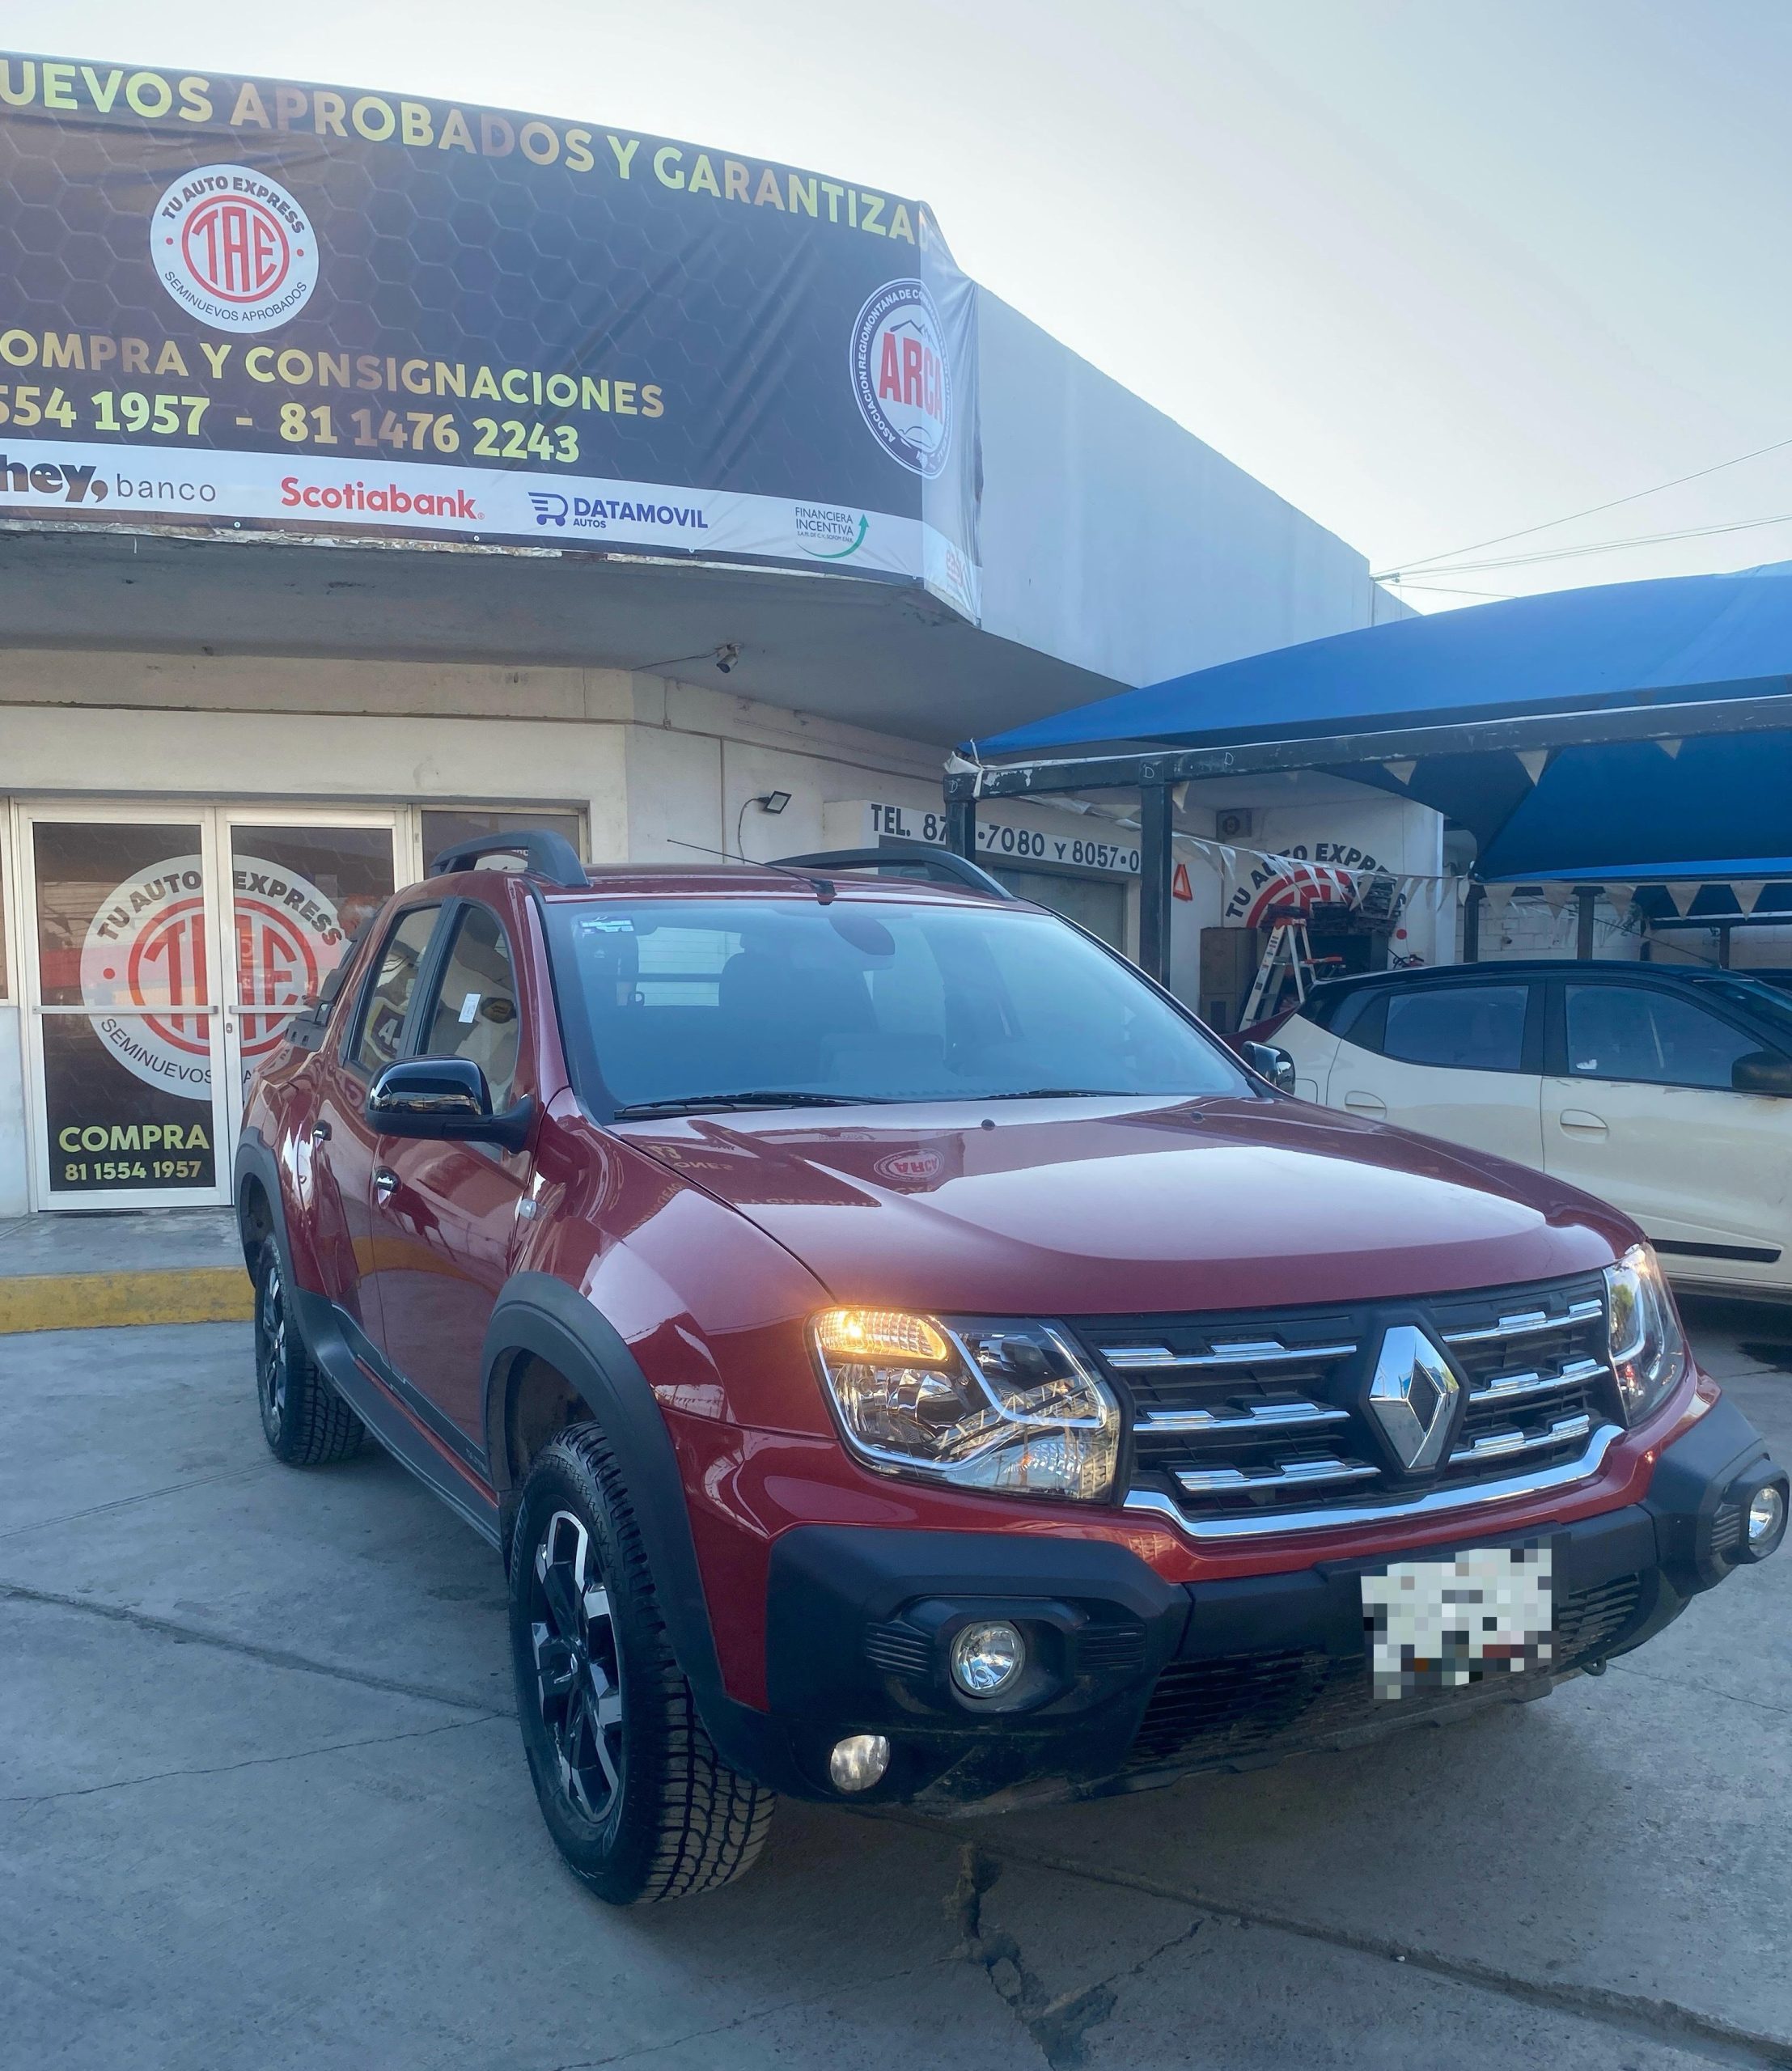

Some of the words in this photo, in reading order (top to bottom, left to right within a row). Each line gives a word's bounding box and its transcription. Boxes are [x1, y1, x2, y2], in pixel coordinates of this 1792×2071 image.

[0, 59, 213, 123] UEVOS
[230, 82, 595, 172] APROBADOS
[606, 135, 640, 180] Y
[162, 197, 184, 219] TU
[182, 176, 228, 202] AUTO
[233, 176, 305, 234] EXPRESS
[192, 206, 277, 292] TAE
[164, 271, 239, 321] SEMINUEVOS
[242, 282, 307, 322] APROBADOS
[899, 288, 912, 302] DE
[858, 290, 900, 370] REGIOMONTANA
[0, 329, 189, 378] OMPRA
[200, 342, 232, 379] Y
[244, 346, 664, 419] CONSIGNACIONES
[879, 332, 944, 425] ARCA
[91, 391, 210, 435] 1957
[279, 402, 337, 444] 81
[350, 408, 460, 453] 1476
[472, 417, 579, 463] 2243
[859, 370, 896, 443] ASOCIACION
[117, 473, 217, 502] banco
[281, 476, 477, 519] Scotiabank
[574, 497, 709, 529] DATAMOVIL
[573, 518, 607, 529] AUTOS
[795, 506, 854, 524] FINANCIERA
[796, 519, 854, 536] INCENTIVA
[871, 803, 911, 837] TEL.
[1054, 842, 1067, 860] Y
[97, 906, 130, 940] TU
[129, 870, 202, 913] AUTO
[234, 870, 342, 947] EXPRESS
[1226, 887, 1252, 919] TU
[59, 1124, 210, 1153] COMPRA
[65, 1163, 87, 1181] 81
[94, 1162, 147, 1180] 1554
[153, 1161, 201, 1179] 1957
